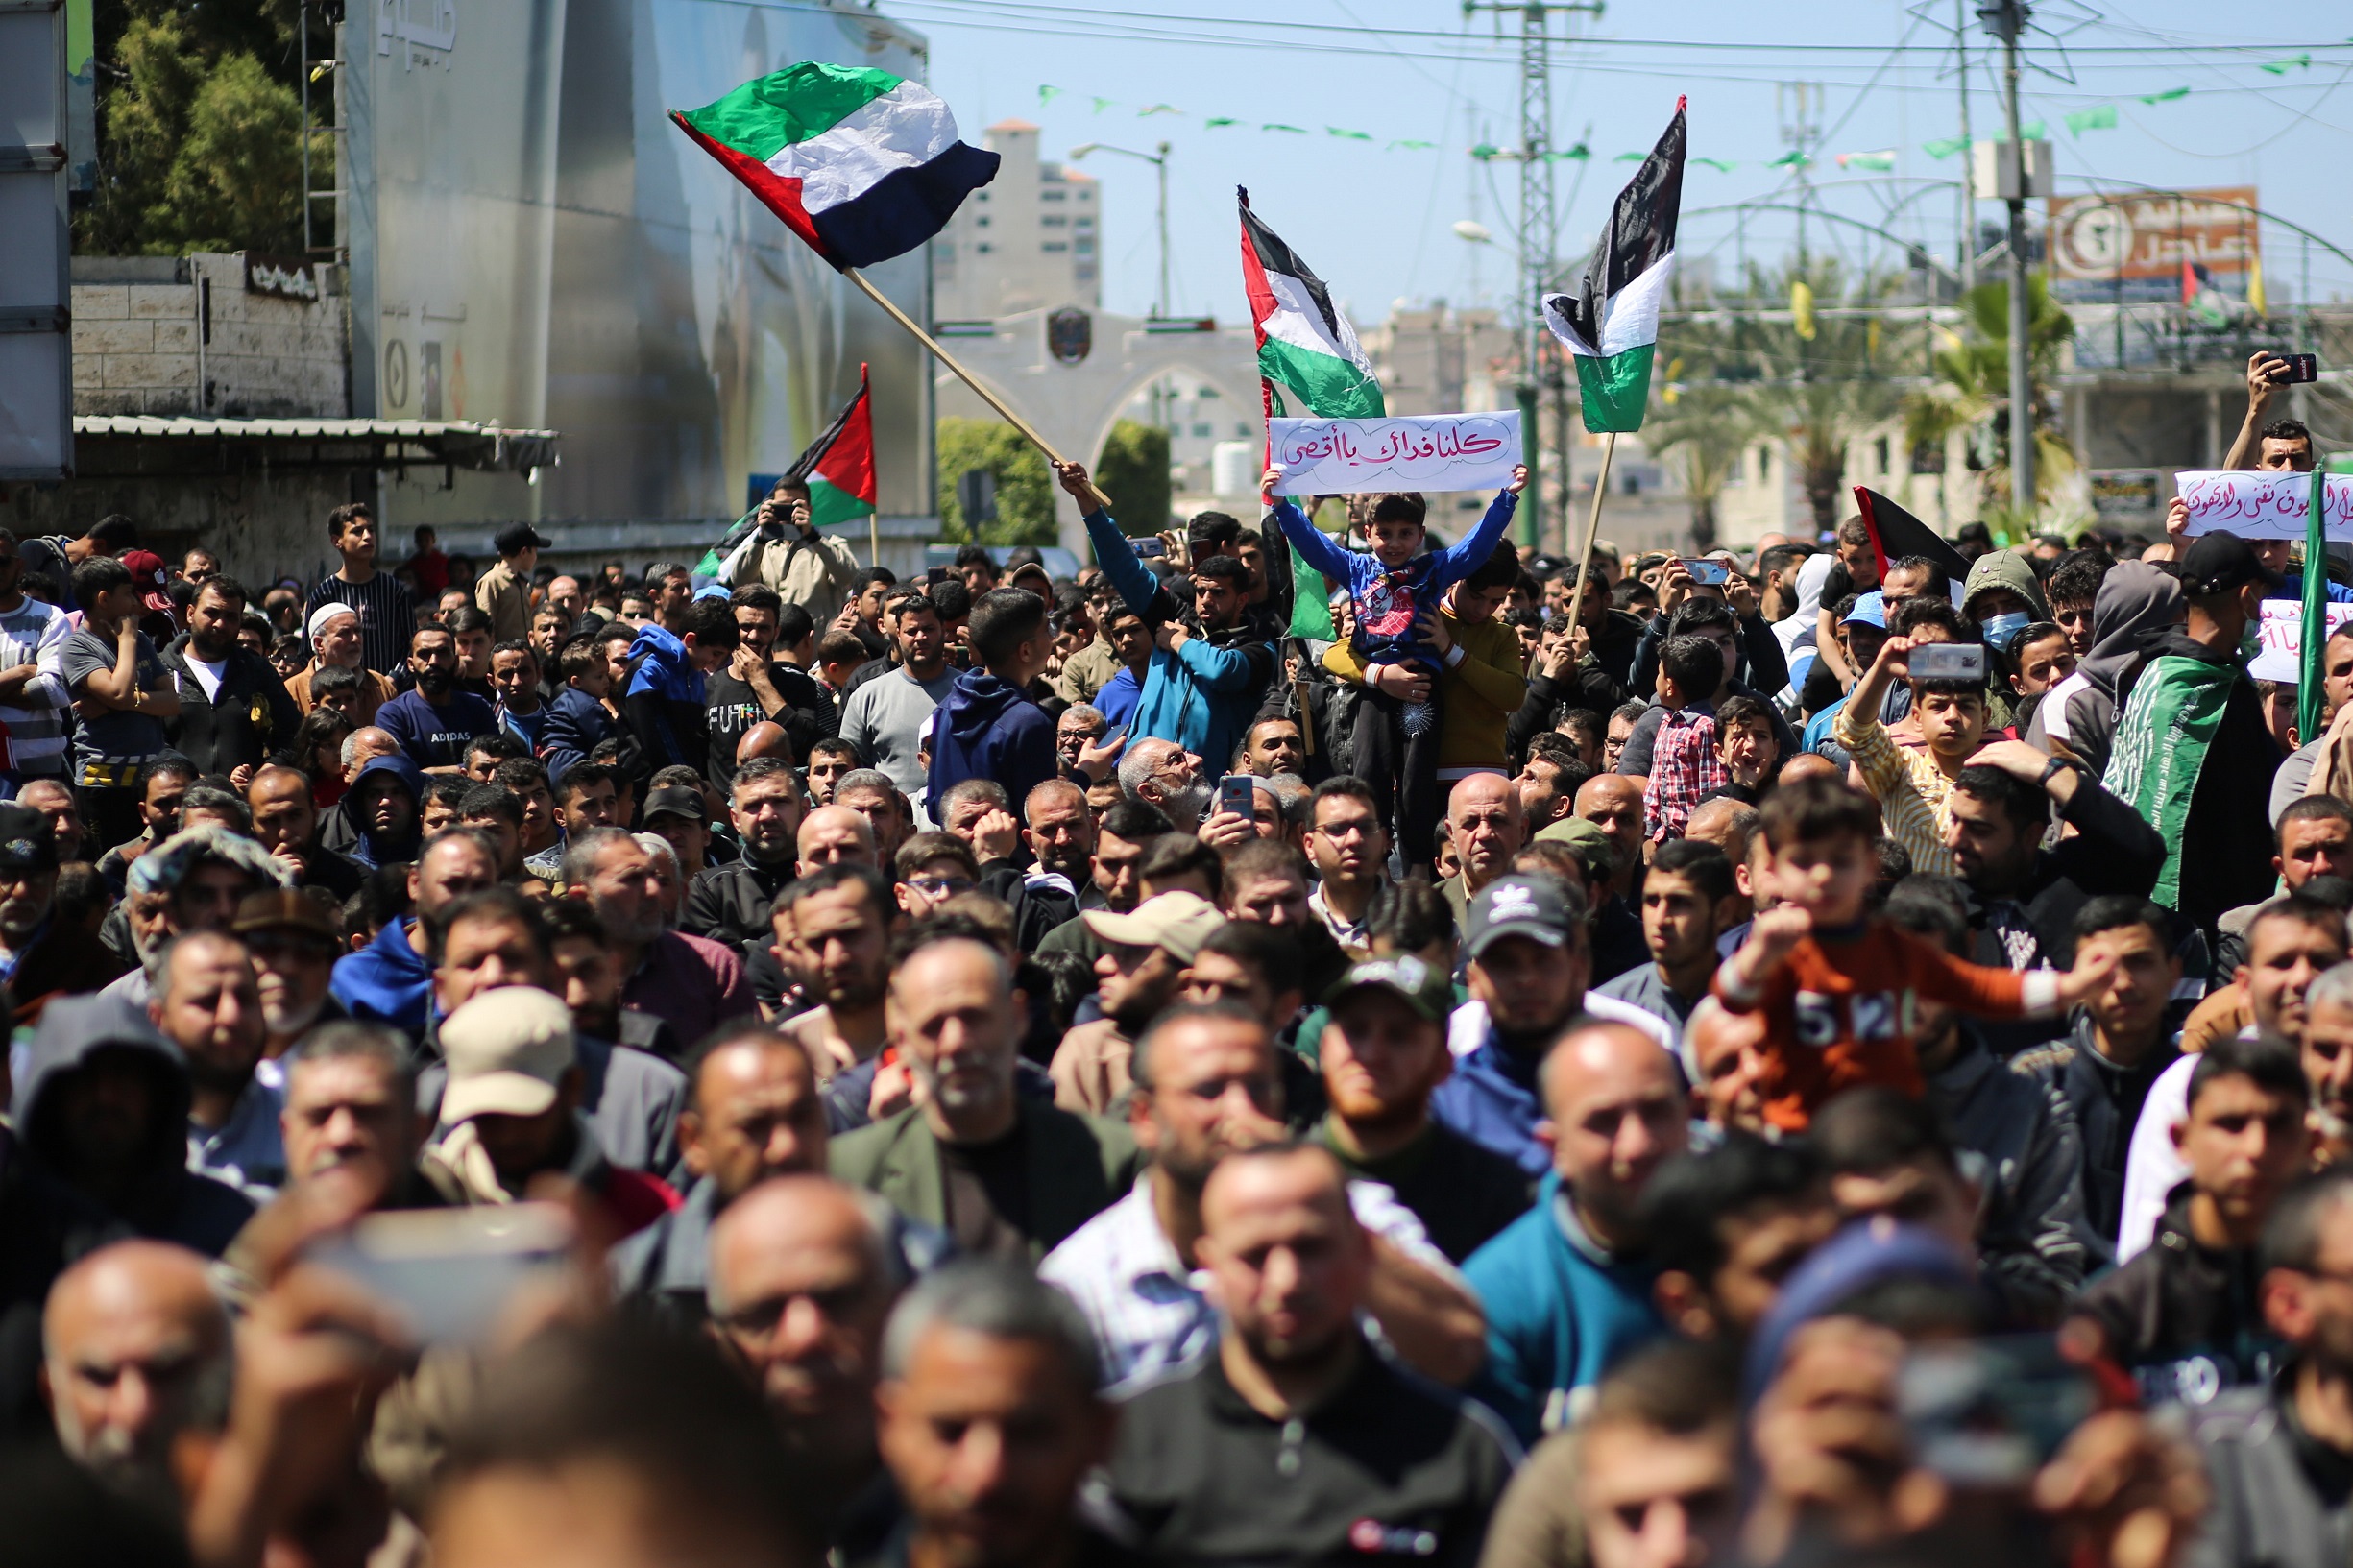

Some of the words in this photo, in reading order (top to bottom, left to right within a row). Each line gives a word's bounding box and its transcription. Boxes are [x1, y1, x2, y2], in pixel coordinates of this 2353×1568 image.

[1358, 430, 1435, 463] فداك
[1437, 425, 1502, 459] كلنا
[431, 732, 471, 742] ADIDAS
